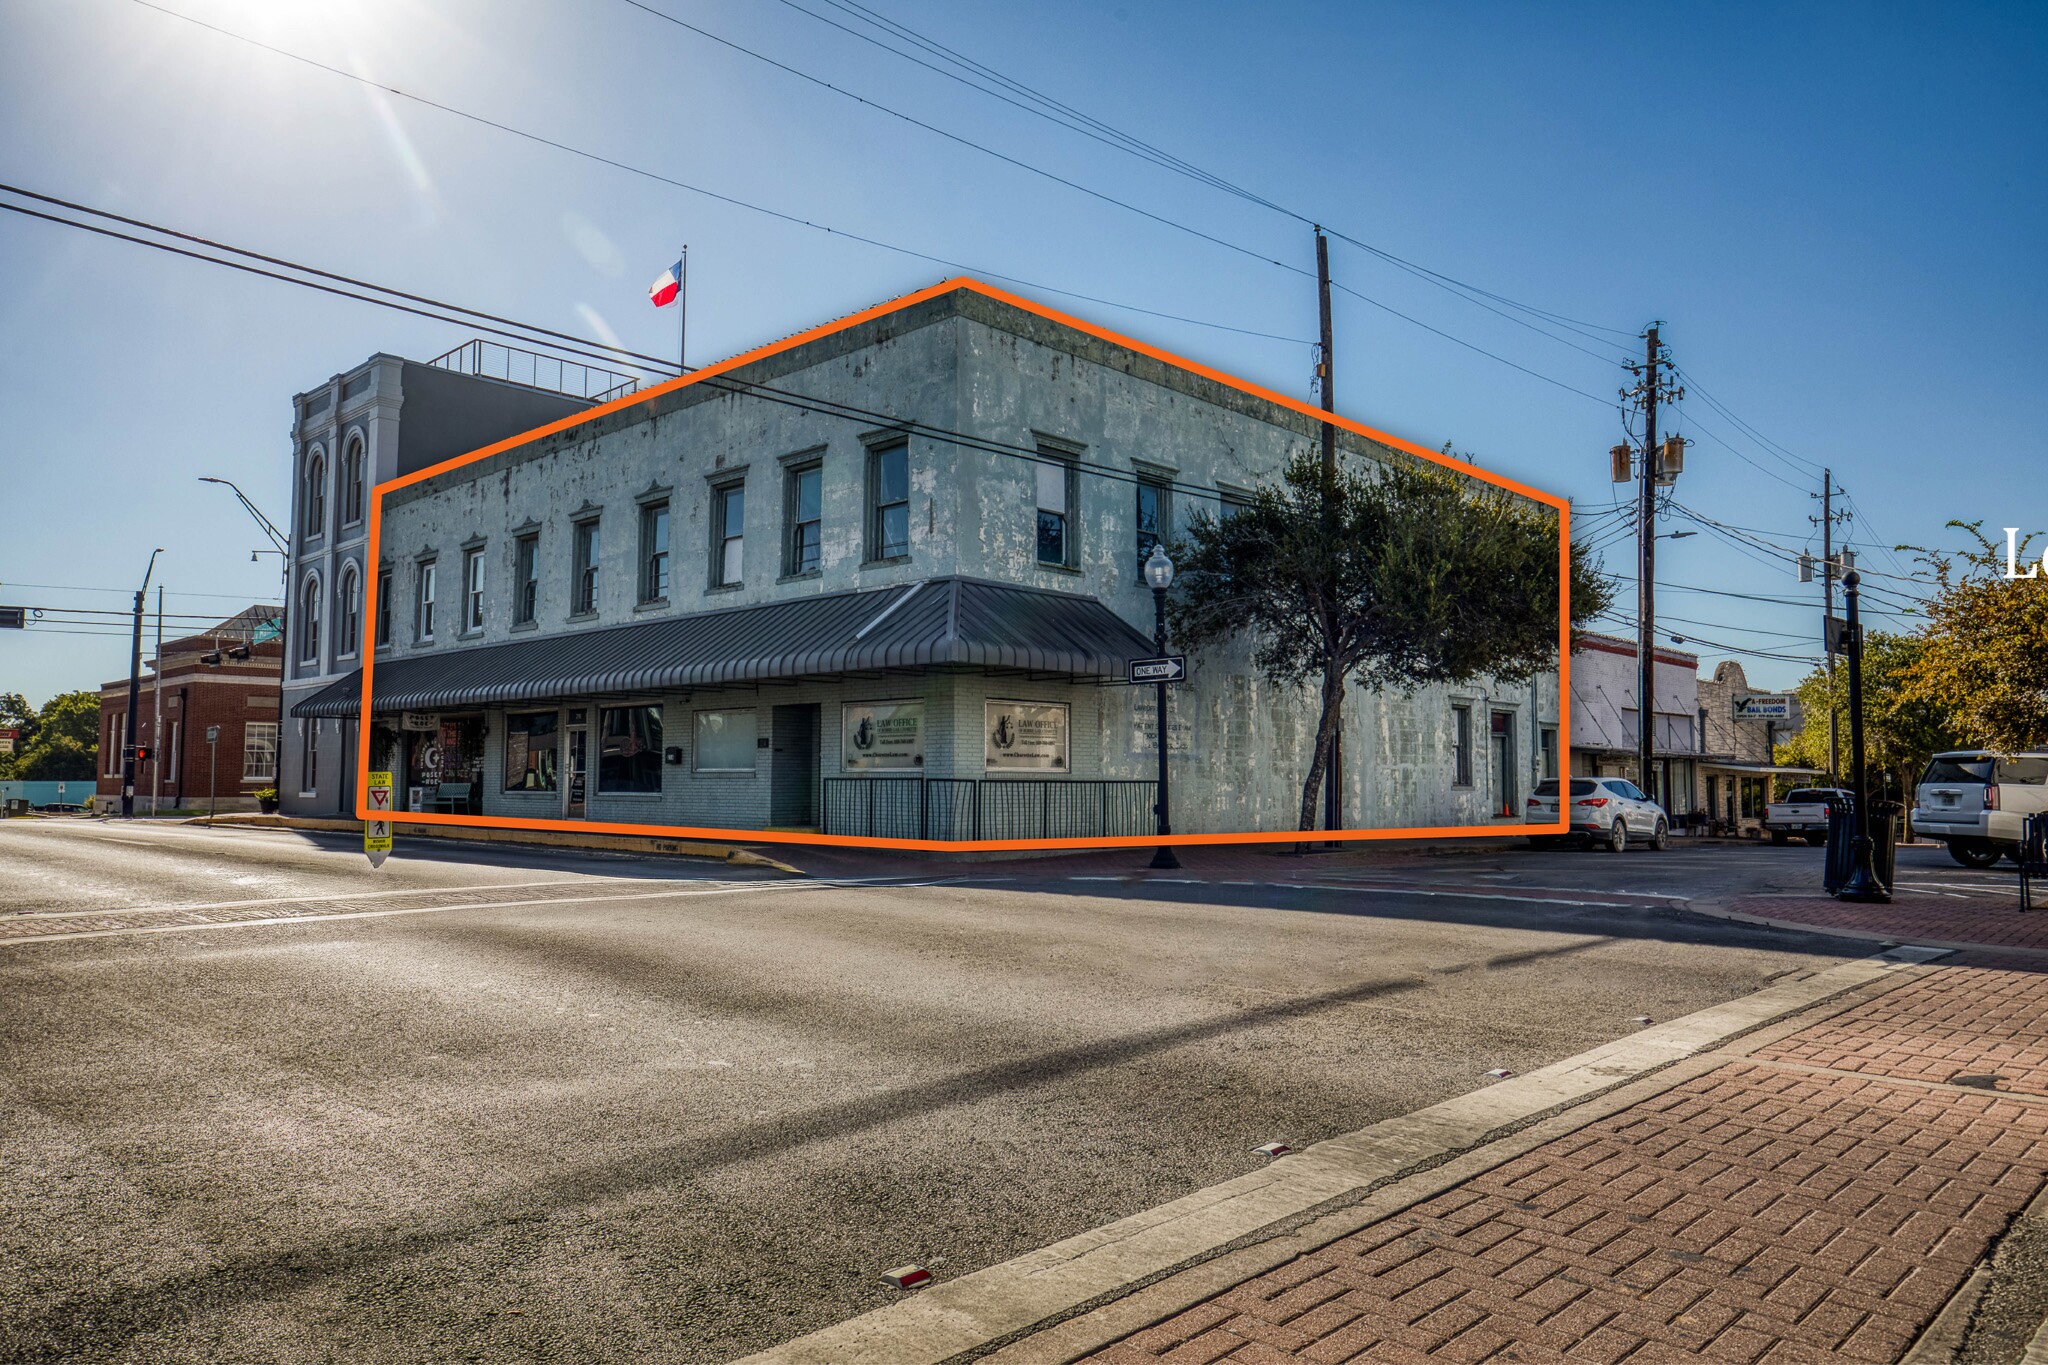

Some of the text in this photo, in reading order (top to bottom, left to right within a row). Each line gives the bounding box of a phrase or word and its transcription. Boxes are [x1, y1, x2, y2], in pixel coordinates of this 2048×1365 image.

[1136, 665, 1168, 676] ONE WAY
[877, 718, 917, 728] LAW OFFICE
[1018, 720, 1058, 729] LAW OFFICE
